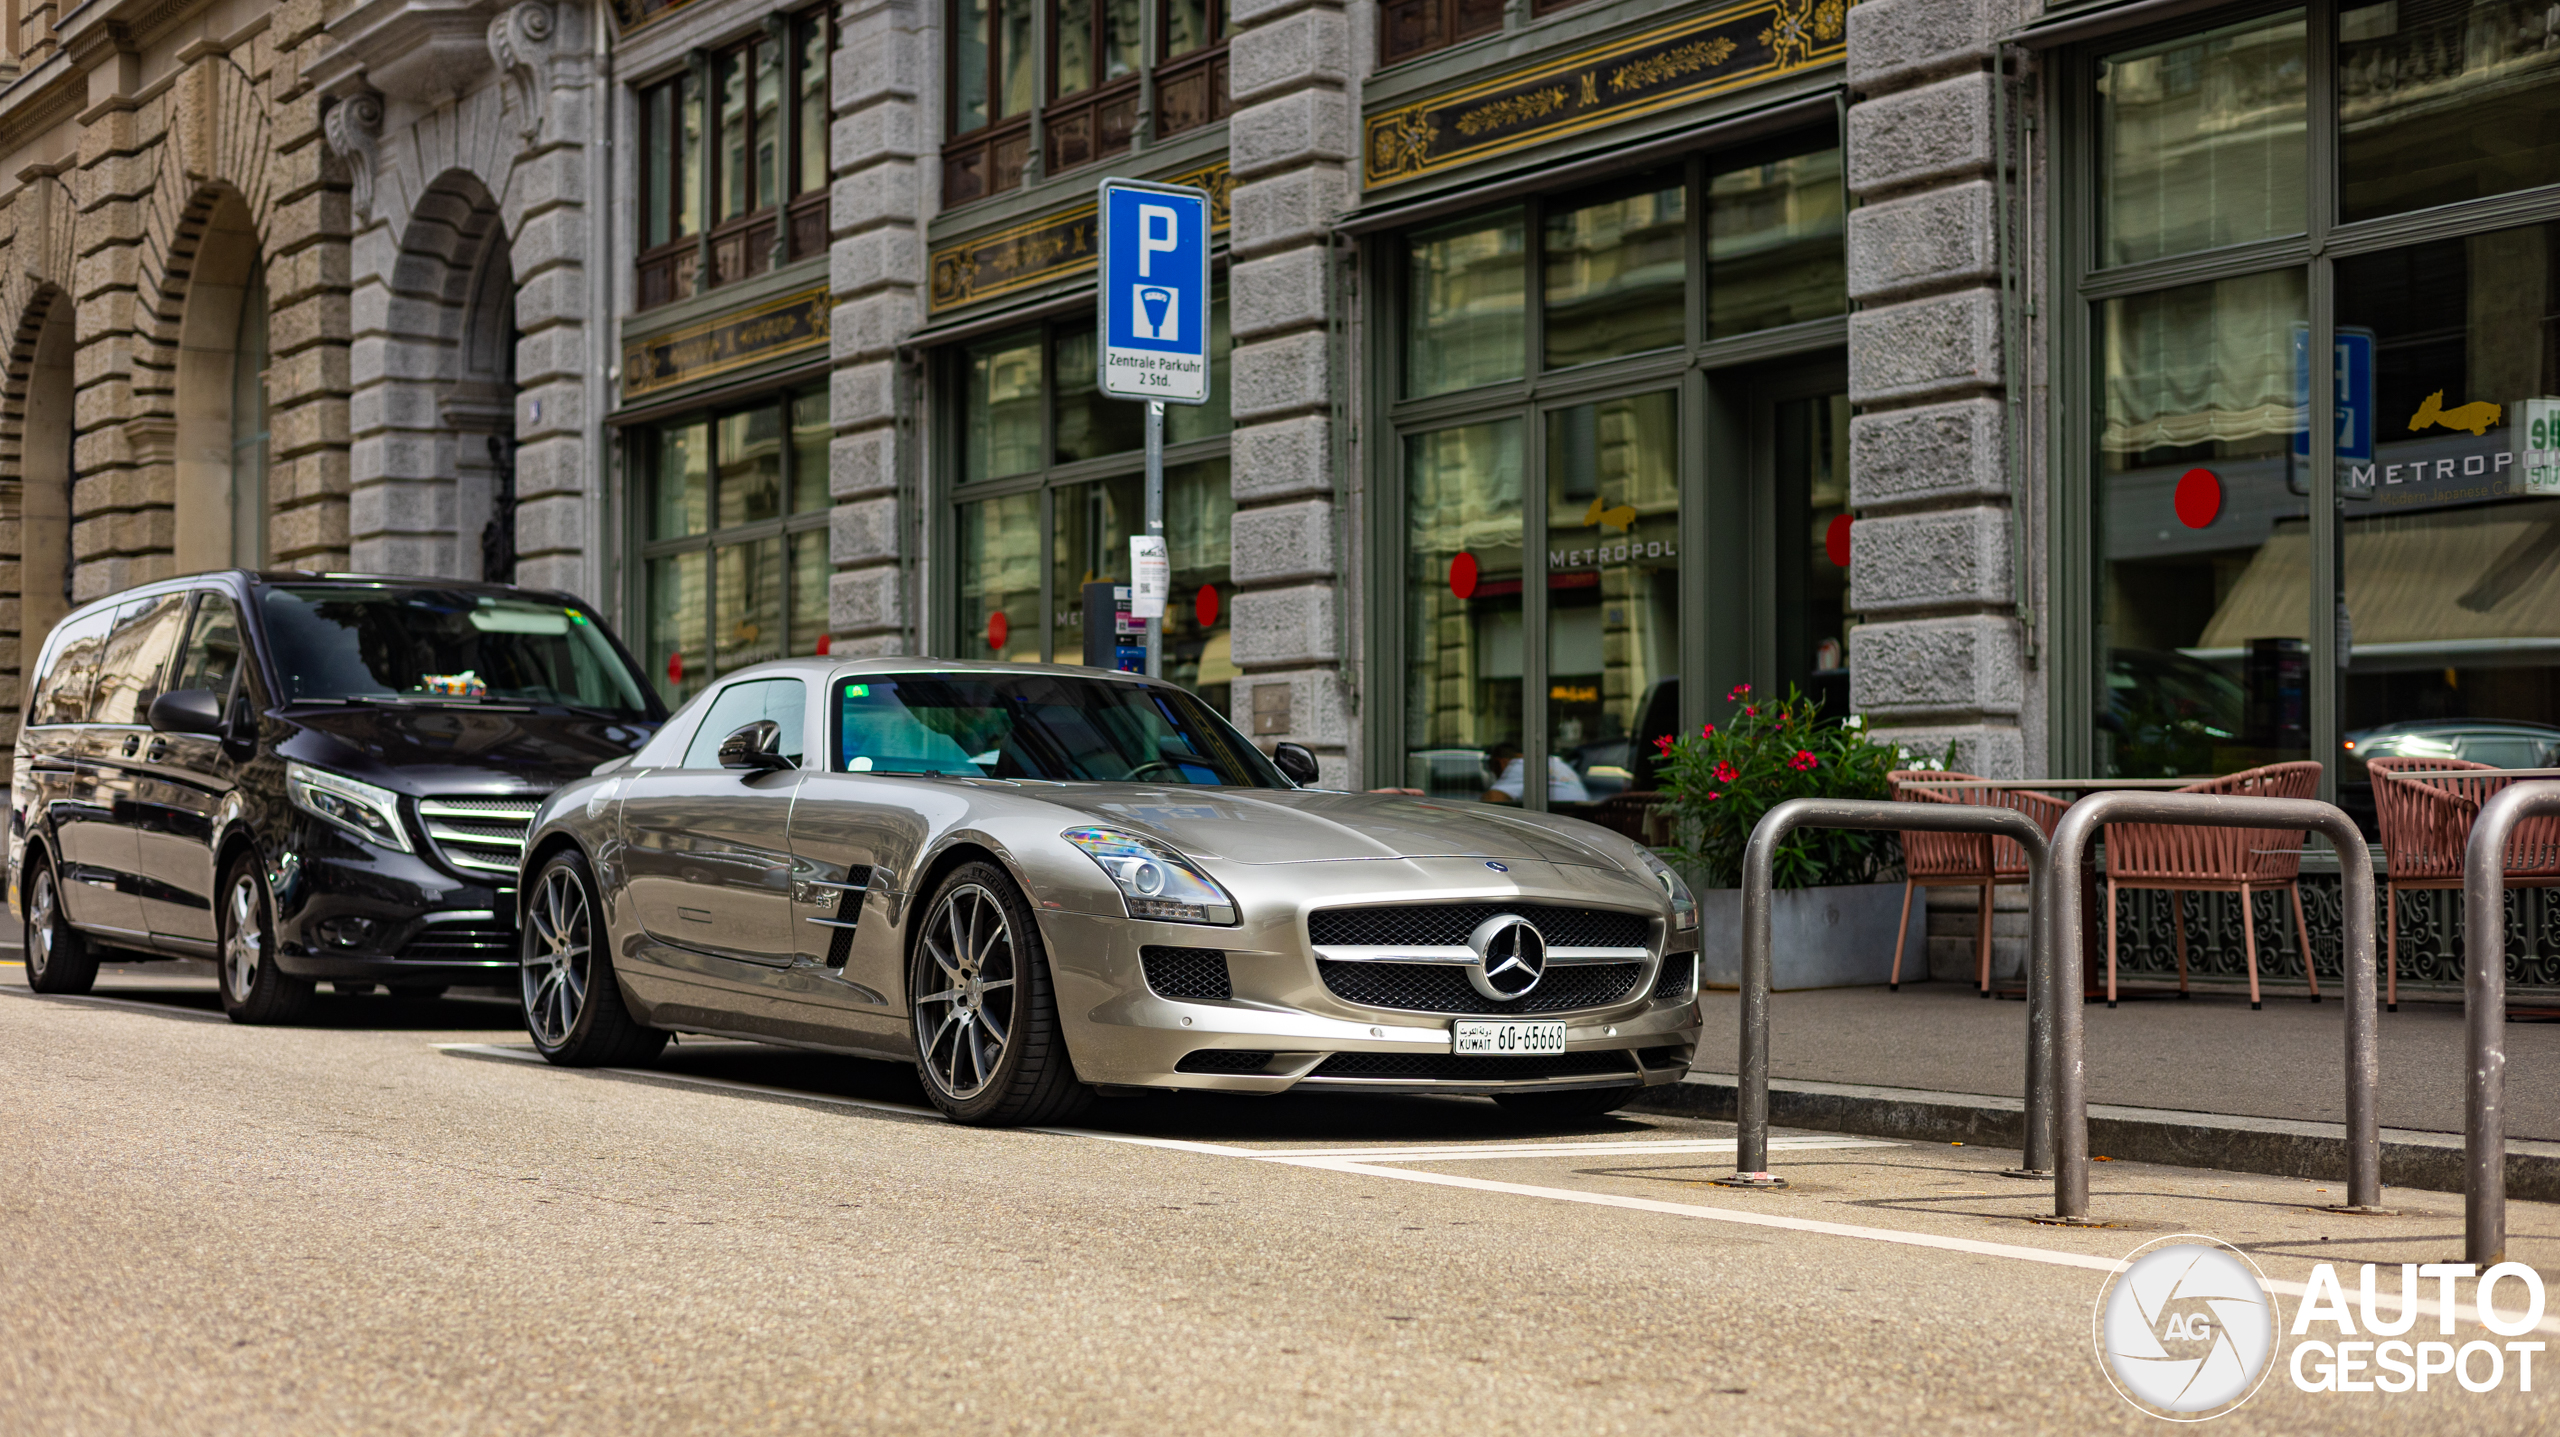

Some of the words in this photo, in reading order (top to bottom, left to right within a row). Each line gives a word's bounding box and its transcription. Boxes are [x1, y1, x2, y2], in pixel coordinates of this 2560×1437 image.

[1139, 204, 1178, 277] P
[1109, 353, 1156, 369] Zentrale
[1159, 358, 1201, 373] Parkuhr
[1139, 372, 1146, 385] 2
[1149, 373, 1171, 387] Std.
[2379, 491, 2427, 506] Modern
[2431, 486, 2489, 504] Japanese
[1549, 540, 1676, 568] METROPOL
[1460, 1026, 1479, 1038] الكويت
[1479, 1026, 1492, 1038] دولة
[1498, 1026, 1562, 1050] 60-65668
[1459, 1039, 1491, 1050] KUWAIT
